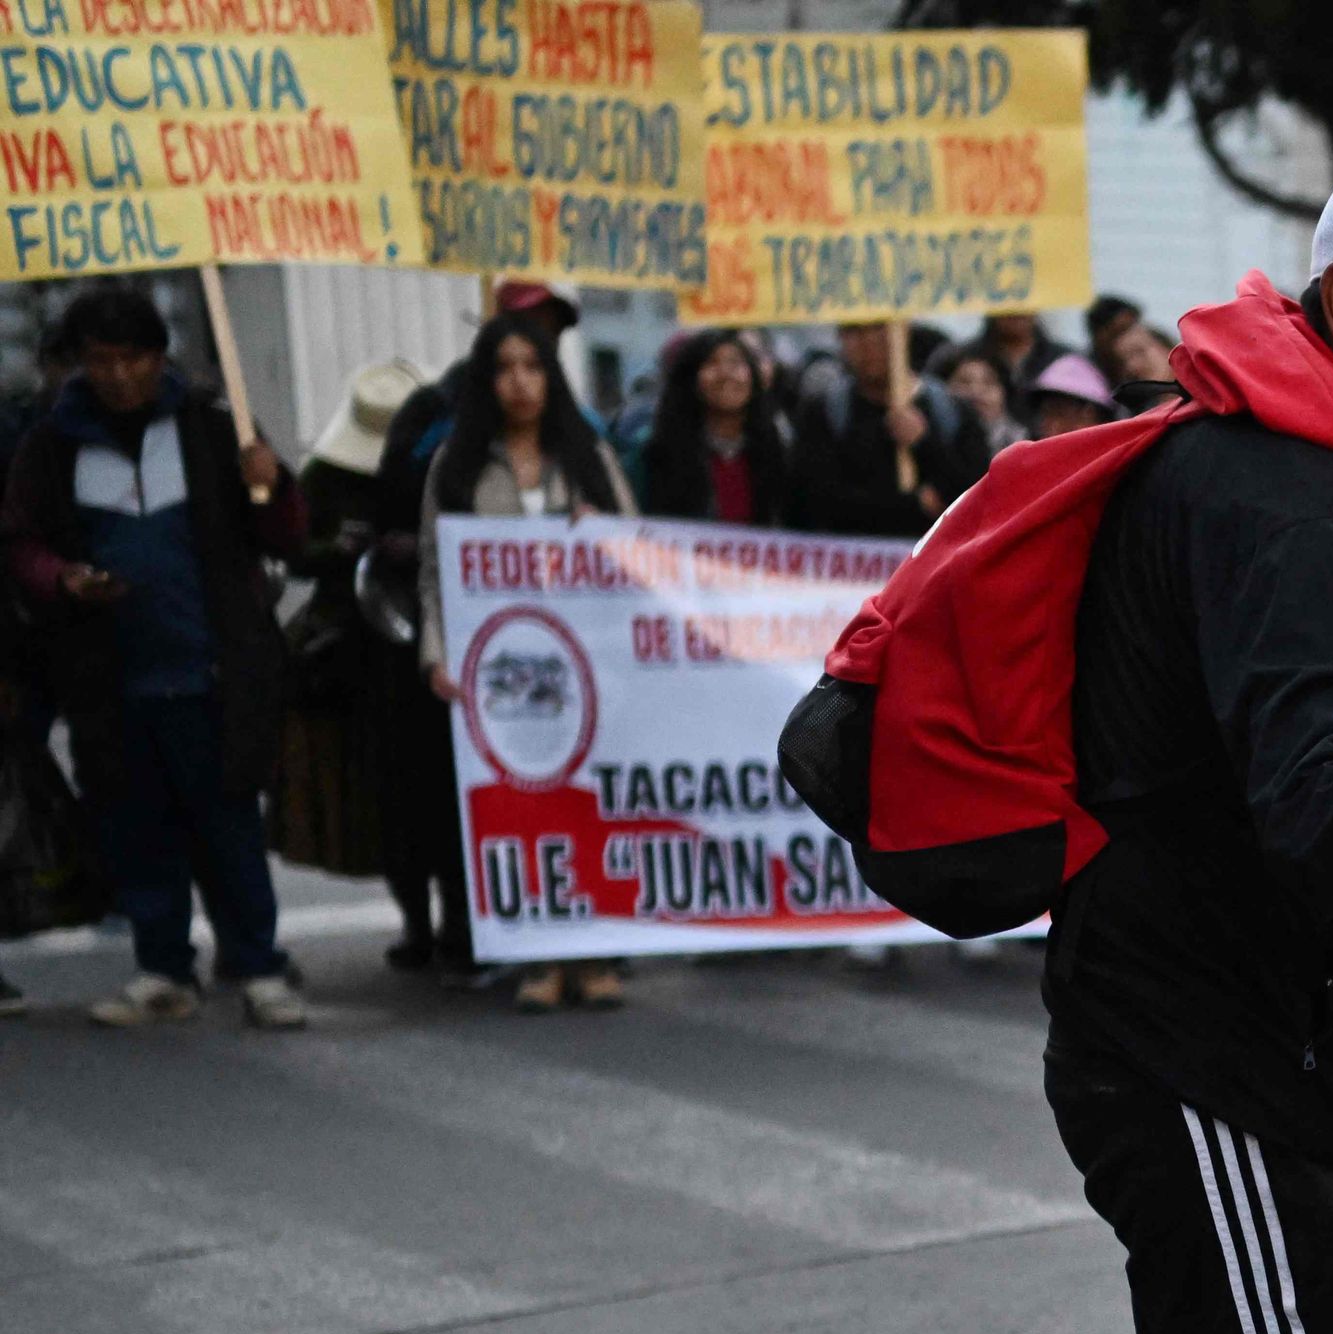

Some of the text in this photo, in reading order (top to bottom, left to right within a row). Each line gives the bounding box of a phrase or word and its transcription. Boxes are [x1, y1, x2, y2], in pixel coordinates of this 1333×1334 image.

[3, 43, 307, 116] EDUCATIVA
[527, 2, 655, 88] HASTA
[703, 42, 1012, 127] STABILIDAD
[82, 121, 141, 189] LA
[159, 106, 360, 187] EDUCACIÓN
[8, 195, 180, 272] FISCAL
[631, 614, 674, 663] DE
[789, 834, 868, 905] SA
